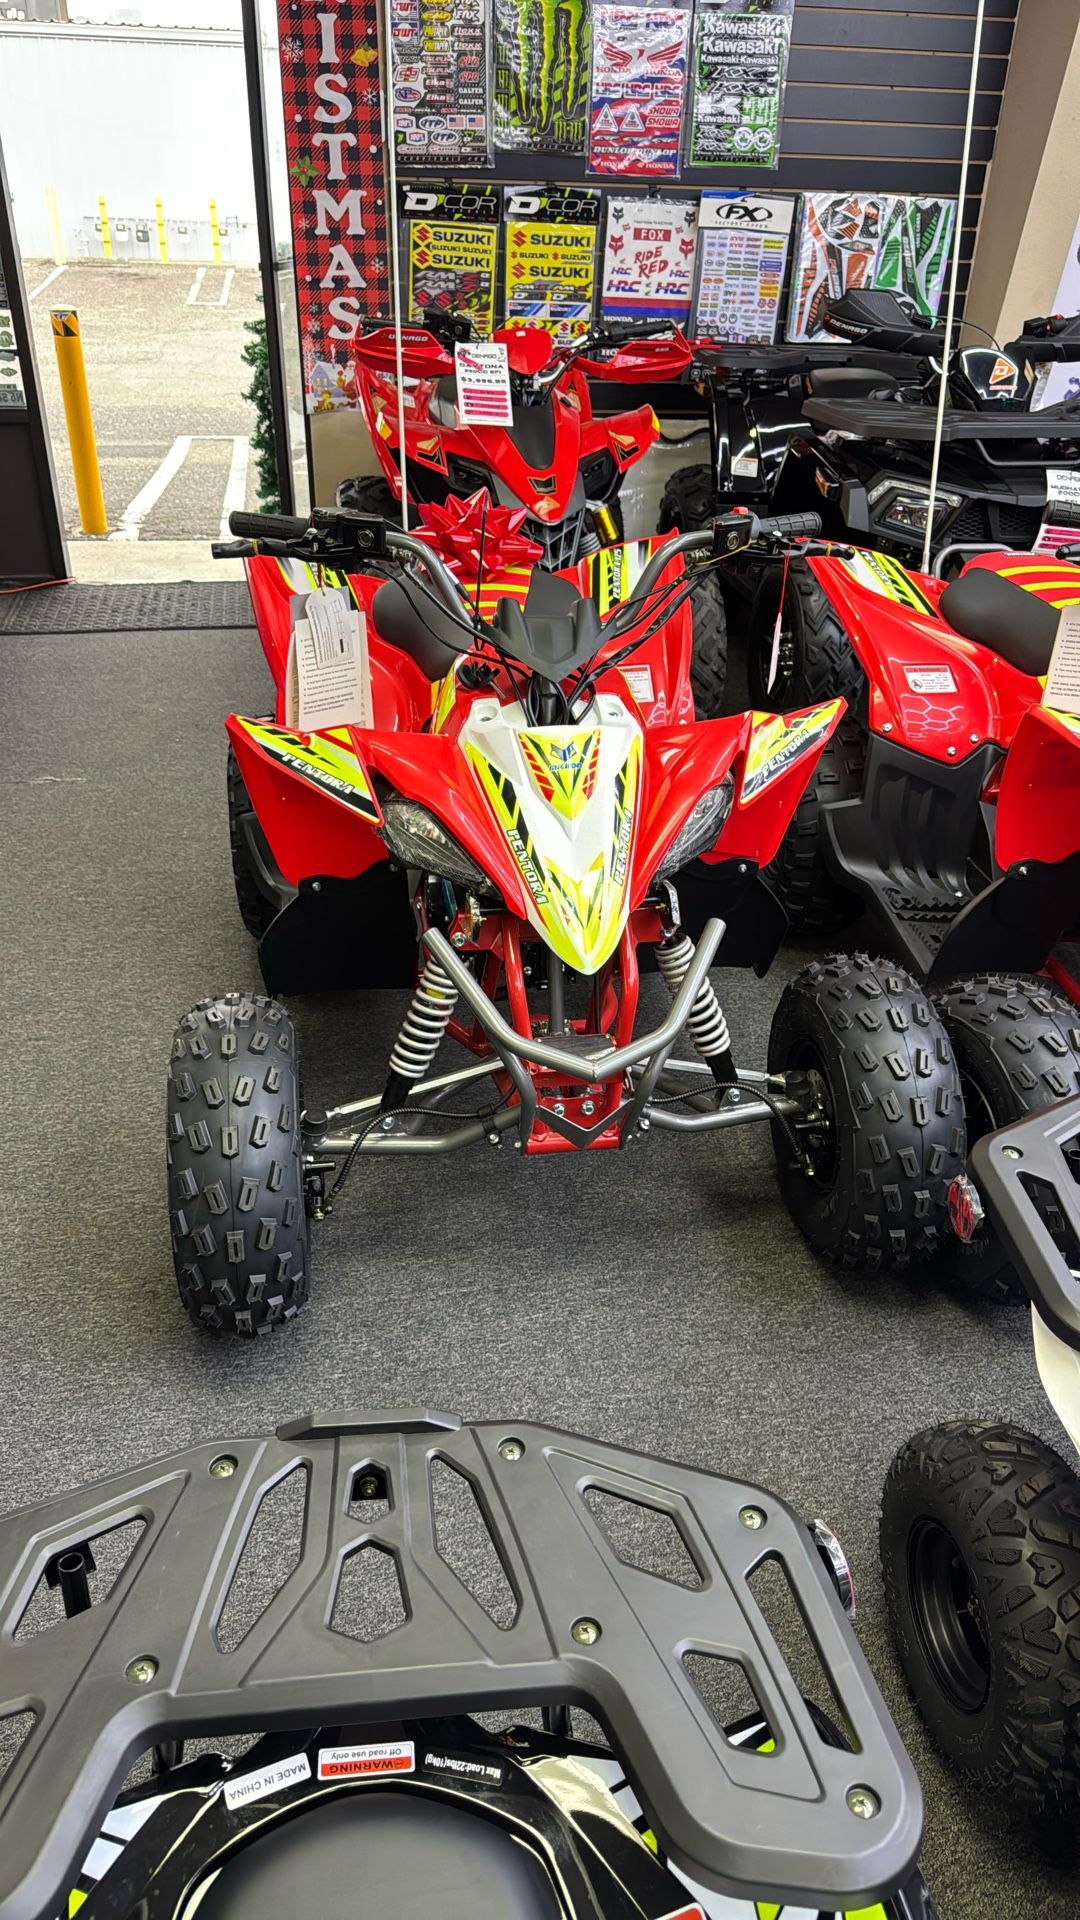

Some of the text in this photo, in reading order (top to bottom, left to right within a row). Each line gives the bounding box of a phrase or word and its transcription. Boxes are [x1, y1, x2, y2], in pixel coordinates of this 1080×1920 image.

[704, 15, 781, 36] Kawasaki
[703, 36, 779, 54] Kawasaki
[701, 55, 778, 65] Kawasaki Kawasaki
[596, 65, 631, 73] HONDA
[646, 69, 681, 77] HONDA
[426, 93, 446, 101] Elka
[648, 106, 680, 115] SHOWA
[424, 119, 445, 127] ITP
[647, 117, 680, 126] SHOWA
[698, 114, 740, 123] Kawasaki
[434, 133, 456, 141] ITP
[593, 146, 635, 155] DUNLOP
[305, 0, 366, 340] ISTMAS
[433, 231, 491, 246] SUZUKI
[530, 234, 591, 248] SUZUKI
[641, 229, 665, 241] FOX
[634, 245, 663, 264] RIDE
[432, 254, 490, 268] SUZUKI
[529, 265, 590, 279] SUZUKI
[611, 267, 632, 275] HRC
[638, 259, 669, 280] RED
[669, 269, 691, 278] HRC
[606, 280, 641, 293] HRC
[655, 282, 690, 295] HRC
[830, 318, 868, 335] DENAGO
[388, 333, 429, 342] DNAGO
[1057, 474, 1080, 482] DENAG
[763, 728, 811, 777] PENTORA
[281, 752, 354, 795] PENTORA
[613, 807, 634, 888] PENTORA
[507, 829, 549, 905] PENTORA
[331, 1752, 349, 1760] only
[390, 1748, 402, 1756] Off
[329, 1760, 393, 1774] WARNING
[486, 1767, 501, 1779] Max
[229, 1763, 307, 1800] MADE IN CHINA
